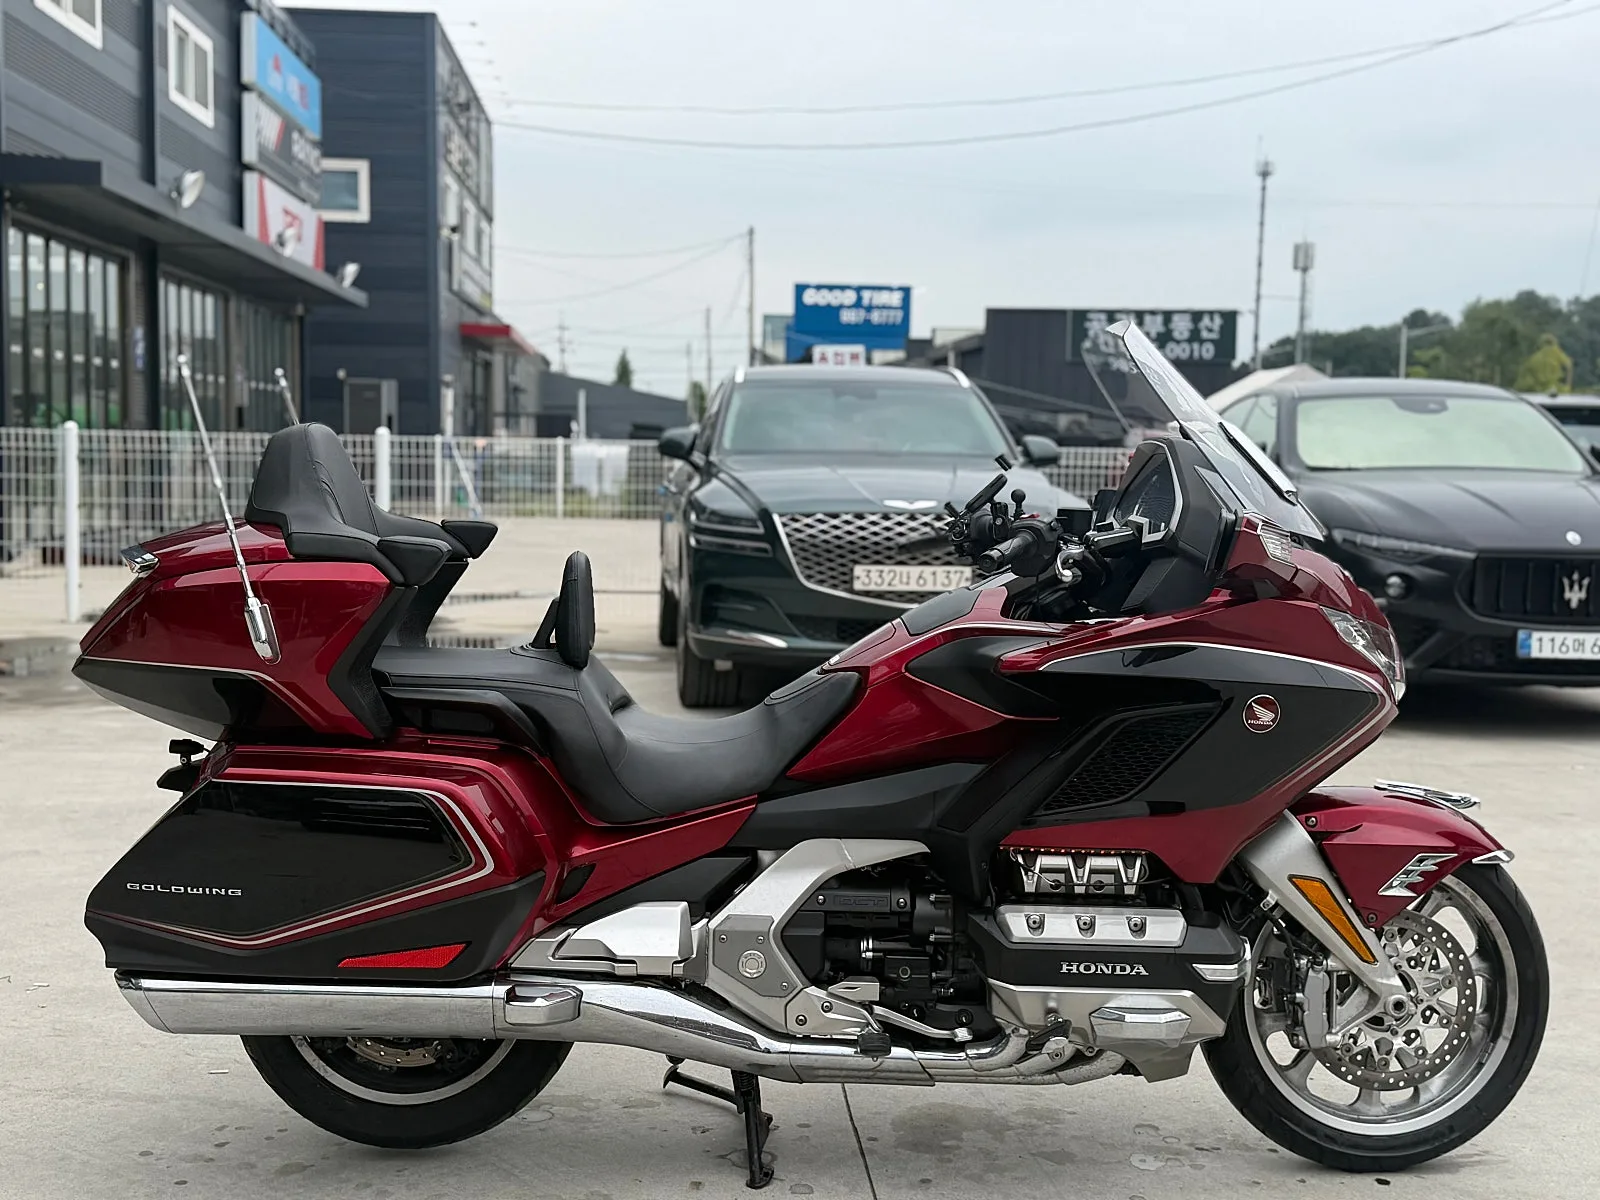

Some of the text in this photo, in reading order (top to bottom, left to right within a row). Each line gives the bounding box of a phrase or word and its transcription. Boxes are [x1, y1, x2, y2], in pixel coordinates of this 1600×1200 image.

[802, 287, 857, 306] GOOD
[915, 570, 965, 588] 6137
[127, 882, 242, 896] GOLDWING
[1060, 962, 1149, 976] HONDA
